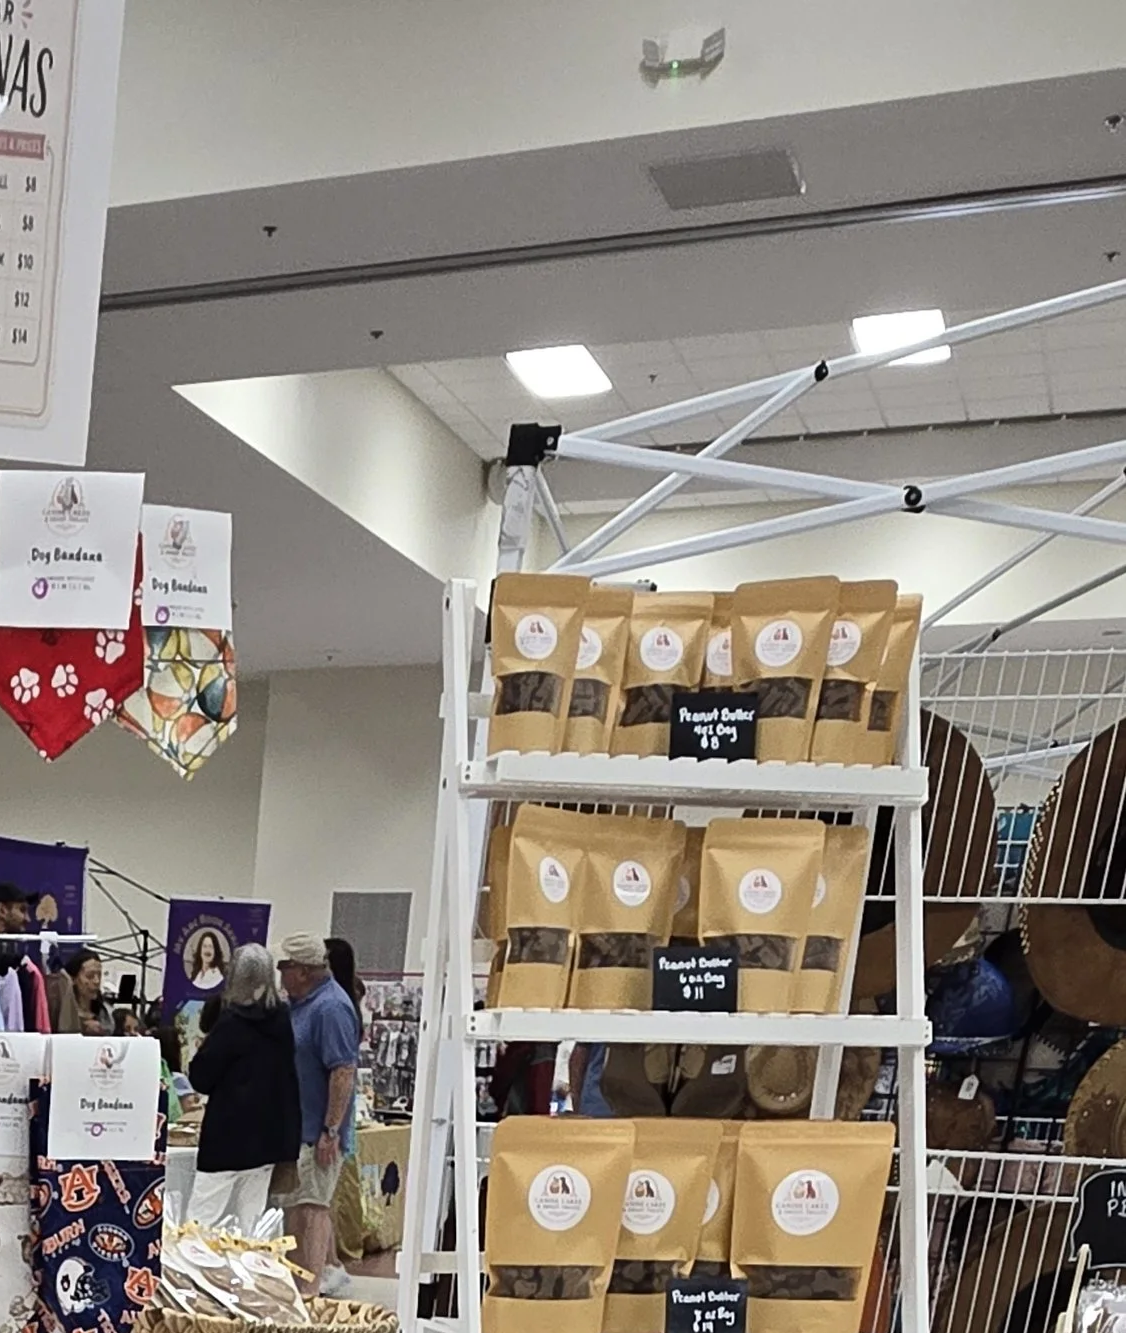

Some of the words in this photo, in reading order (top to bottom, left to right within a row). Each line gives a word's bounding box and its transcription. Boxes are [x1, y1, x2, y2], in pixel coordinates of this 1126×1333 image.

[22, 214, 34, 231] $8
[18, 253, 34, 270] $10
[15, 290, 30, 308] $12
[12, 327, 28, 344] $14
[31, 547, 51, 564] Dog
[53, 547, 103, 563] Bandana
[152, 577, 169, 595] Dog
[170, 578, 209, 595] Bandana
[679, 706, 719, 723] Peanut
[720, 707, 755, 722] Butter
[715, 723, 738, 743] Bag
[658, 956, 697, 971] Peanut
[698, 956, 733, 969] Butter
[703, 971, 725, 989] Bag
[80, 1097, 96, 1112] Dog
[97, 1098, 134, 1110] Bandana
[671, 1288, 706, 1304] Peanut
[707, 1290, 740, 1303] Butter
